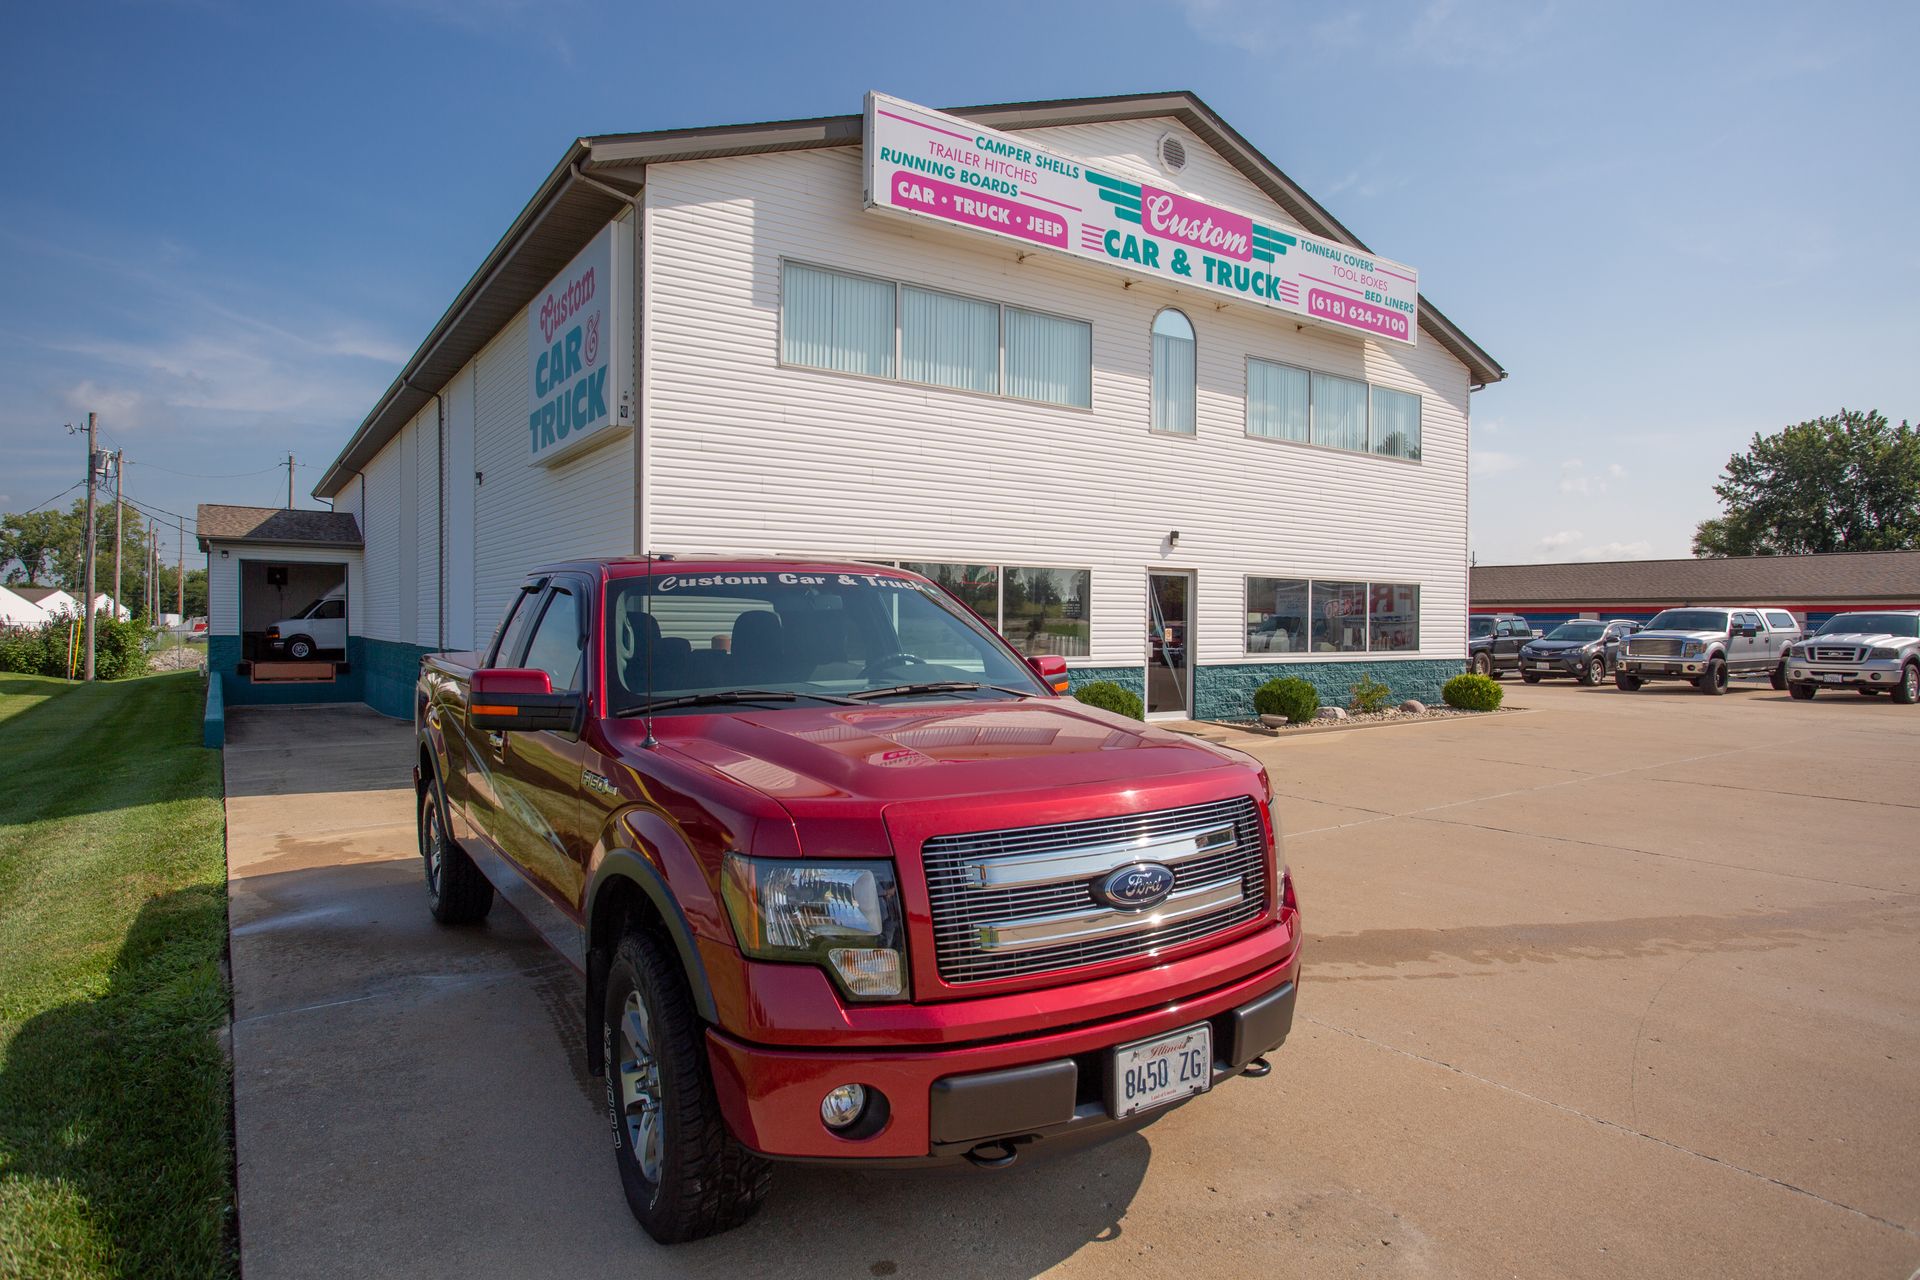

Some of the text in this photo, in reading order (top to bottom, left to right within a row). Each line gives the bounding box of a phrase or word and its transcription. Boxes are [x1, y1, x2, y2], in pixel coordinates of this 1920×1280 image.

[880, 147, 1018, 197] RUNNING BOARDS
[929, 141, 1037, 185] TRAILER HITCHES
[976, 136, 1079, 179] CAMPER SHELLS
[898, 181, 1063, 237] CAR TRUCK JEEP
[1147, 195, 1248, 255] Custom
[1104, 229, 1282, 302] CAR & TRUCK
[1300, 240, 1374, 273] TONNEAU COVERS
[1332, 265, 1388, 292] TOOL BOXES
[540, 266, 595, 344] Custom
[1311, 293, 1406, 333] (618) 624-7100
[1365, 289, 1415, 313] BED LINERS
[535, 325, 582, 399] CAR
[529, 364, 607, 453] TRUCK
[658, 573, 925, 592] Custom Car & Truck
[1326, 598, 1352, 619] OPEN
[1126, 872, 1162, 897] Ford
[1125, 1049, 1202, 1099] 8450 ZG
